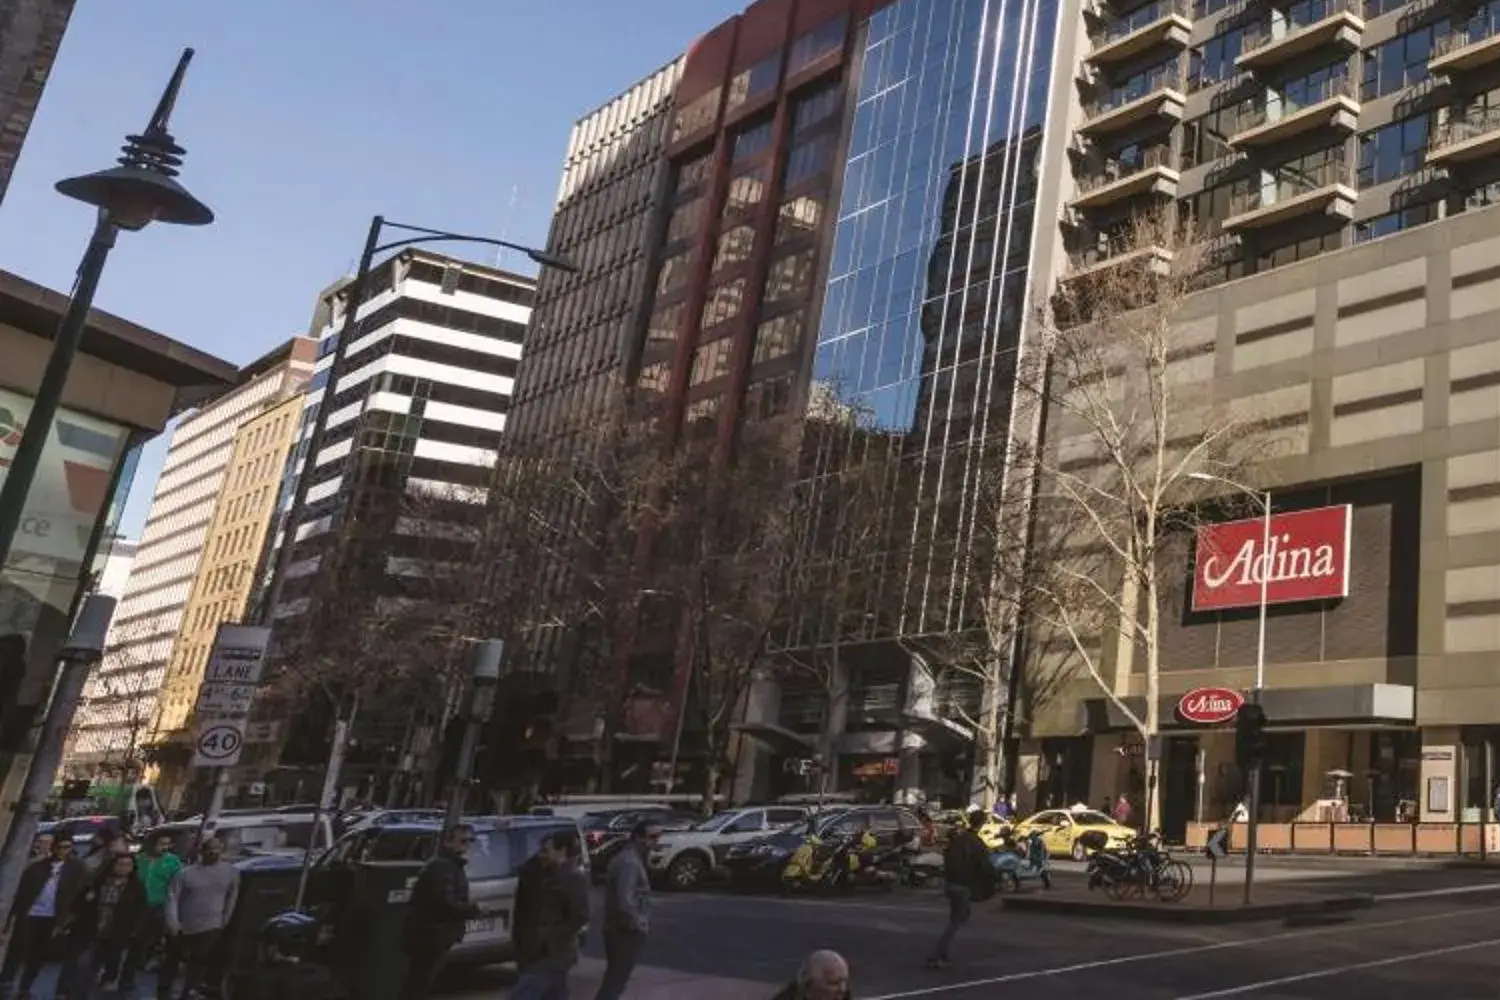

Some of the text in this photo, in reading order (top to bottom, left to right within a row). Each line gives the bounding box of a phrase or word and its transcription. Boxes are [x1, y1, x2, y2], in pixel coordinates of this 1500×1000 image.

[1204, 534, 1335, 588] Adina
[213, 663, 252, 679] LANE
[1187, 695, 1232, 713] Adina
[203, 733, 237, 751] 40
